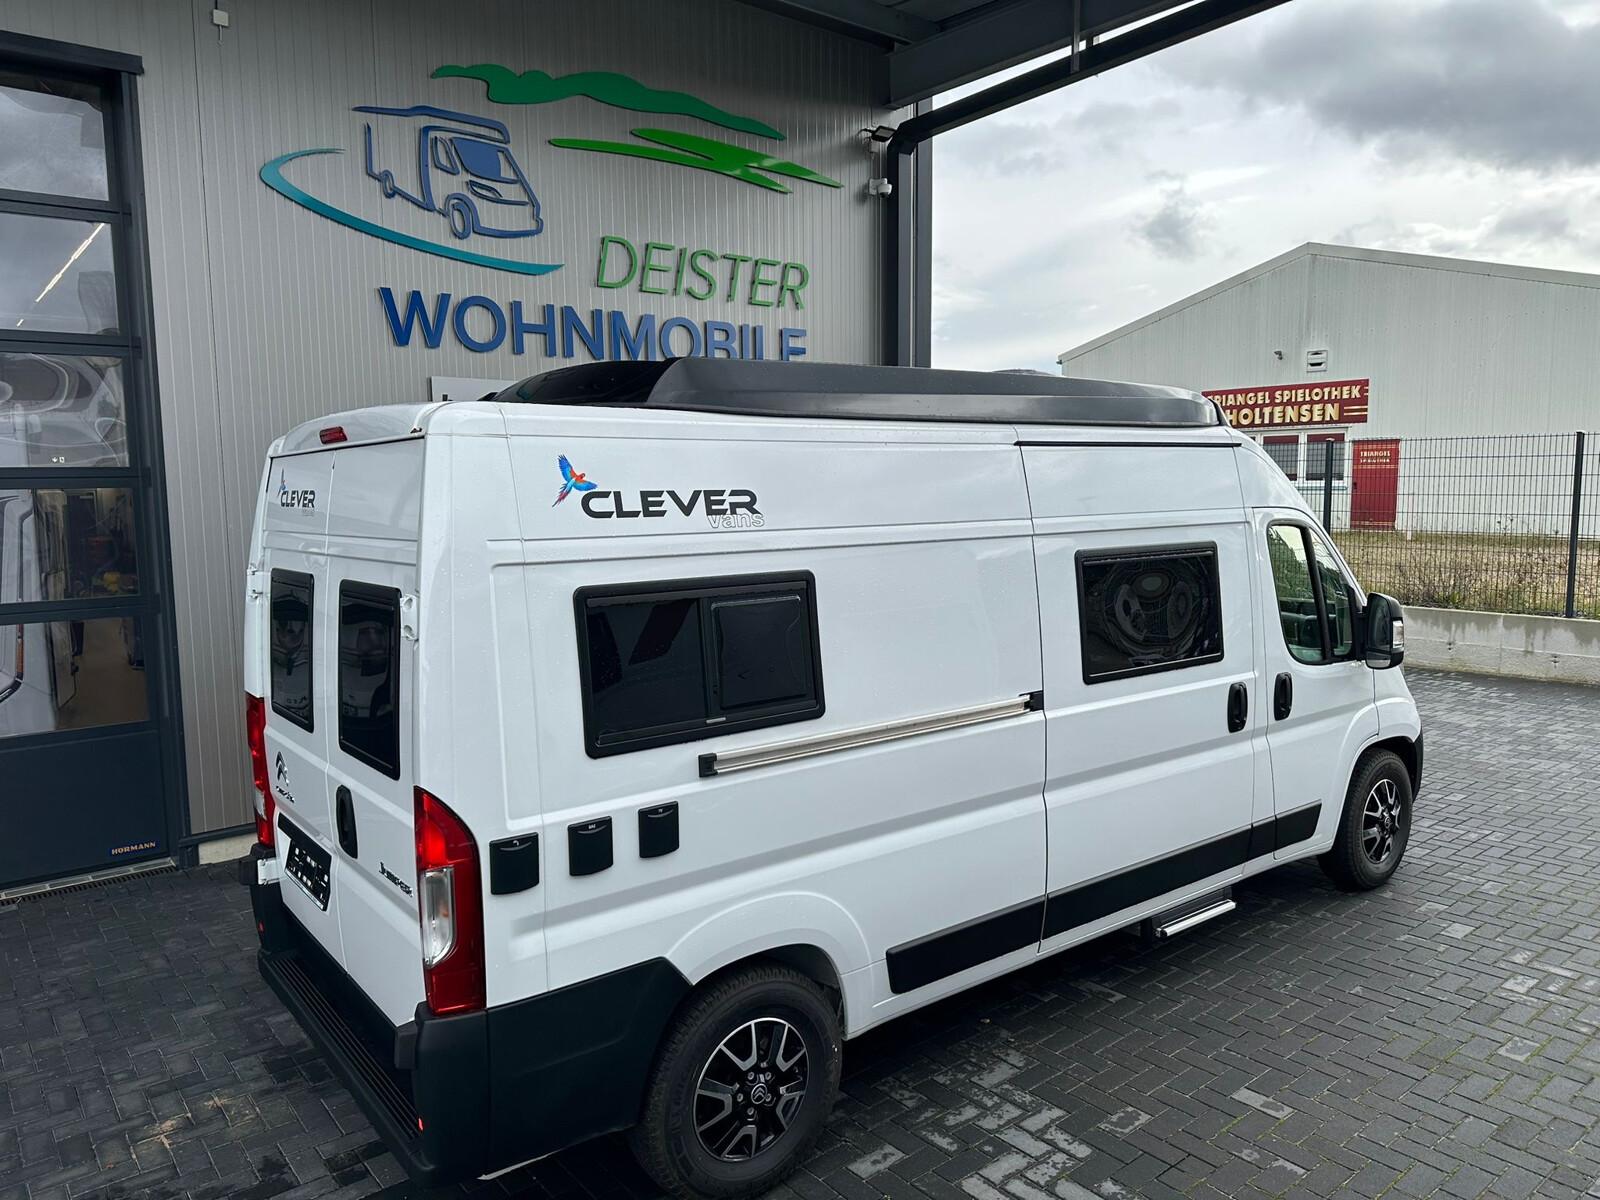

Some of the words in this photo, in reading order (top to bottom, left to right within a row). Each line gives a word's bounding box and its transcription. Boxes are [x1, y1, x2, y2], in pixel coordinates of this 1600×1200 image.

[597, 236, 809, 310] DEISTER
[379, 287, 807, 361] WOHNMOBILE
[1208, 391, 1270, 406] RIANGEL
[1275, 385, 1361, 403] SPIELOTHEK
[1226, 403, 1339, 426] HOLTENSEN
[280, 490, 316, 508] CLEVER
[581, 489, 762, 519] CLEVER
[706, 512, 765, 529] vans
